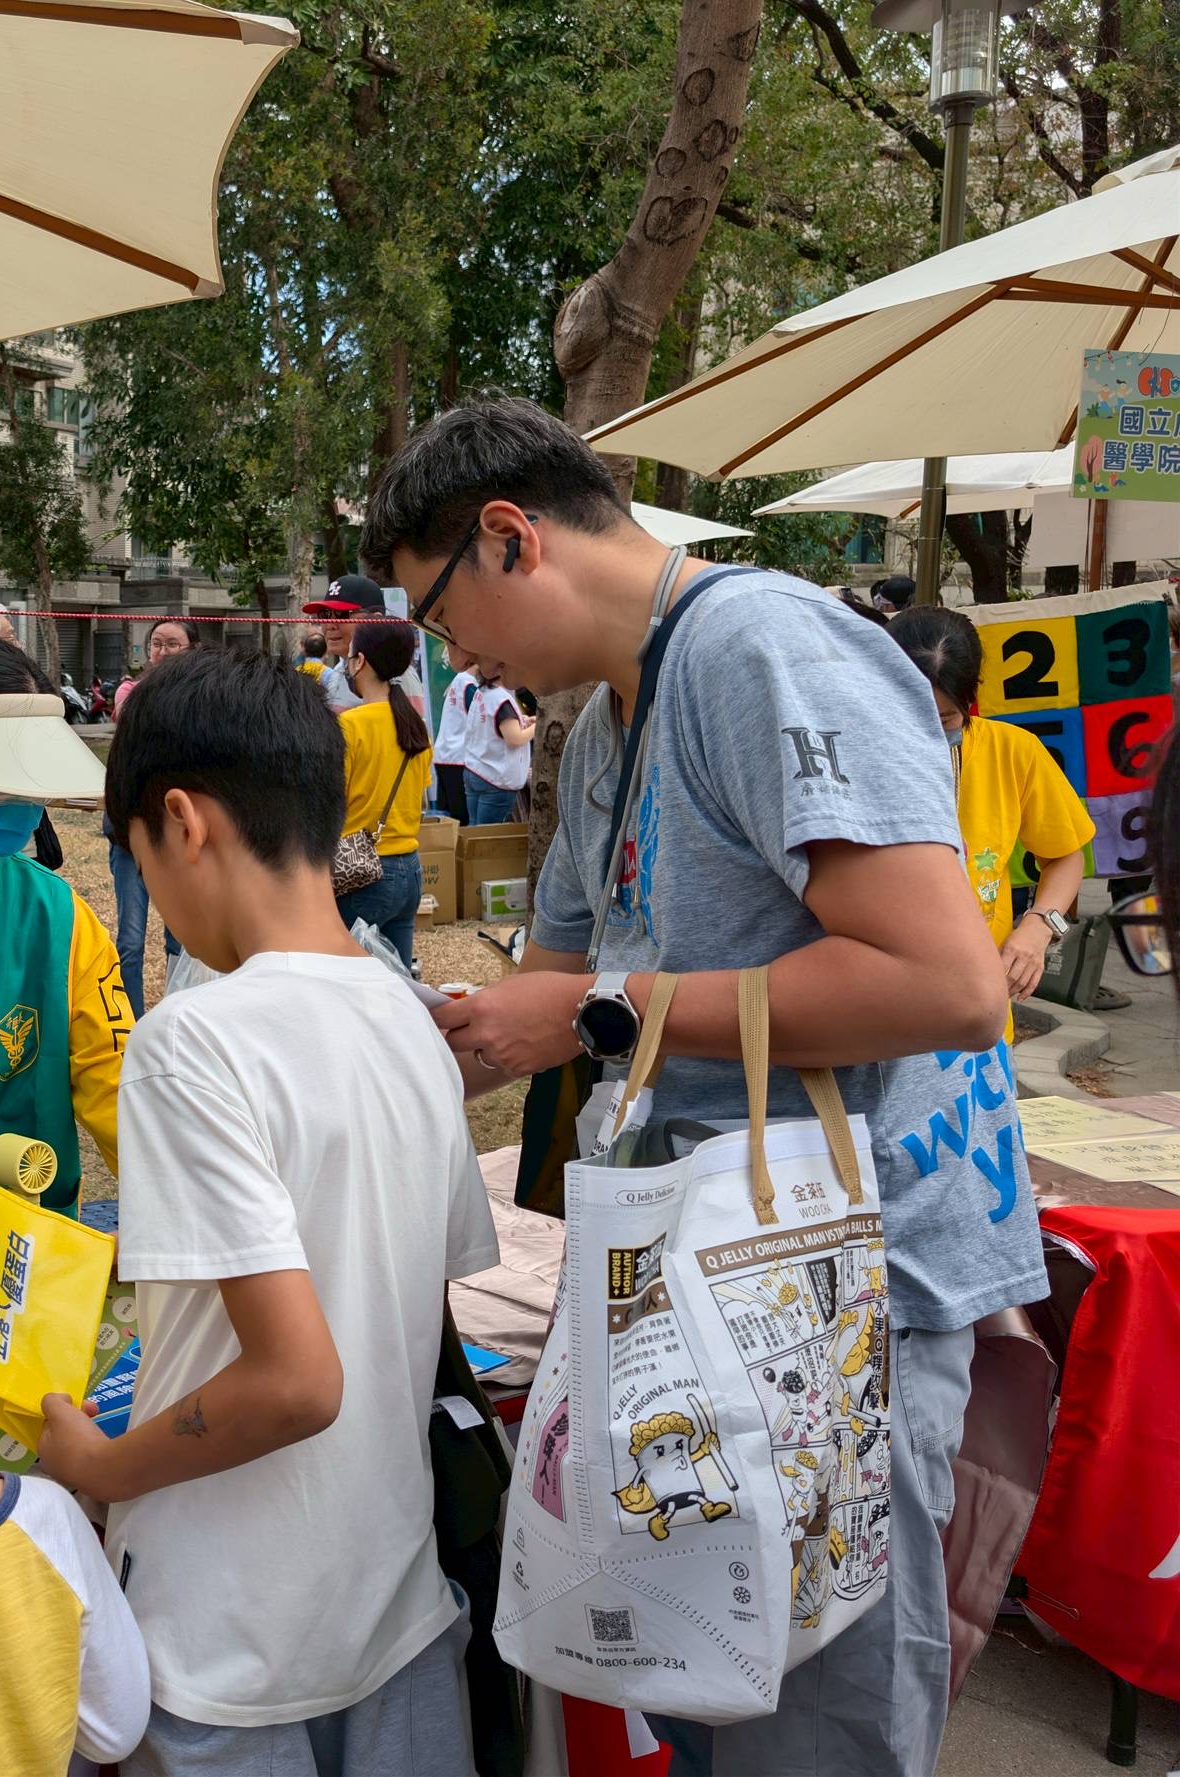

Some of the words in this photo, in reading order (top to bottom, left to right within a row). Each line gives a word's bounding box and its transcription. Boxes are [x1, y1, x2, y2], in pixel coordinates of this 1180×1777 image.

[1120, 406, 1180, 437] 國立
[1104, 442, 1180, 473] 醫學院
[1002, 630, 1059, 700] 2
[1103, 618, 1150, 687] 3
[781, 727, 850, 784] H
[1108, 712, 1159, 777] 6
[612, 1252, 621, 1287] BRAND
[706, 1255, 719, 1270] Q
[719, 1246, 754, 1266] JELLY
[755, 1235, 805, 1257] ORIGINAL
[803, 1231, 826, 1248] MAN
[623, 1252, 631, 1294] AUTHOR
[619, 1384, 639, 1413] JELLY
[628, 1383, 672, 1420] ORIGINAL
[672, 1378, 700, 1391] MAN
[596, 1657, 687, 1671] 0800-600-234
